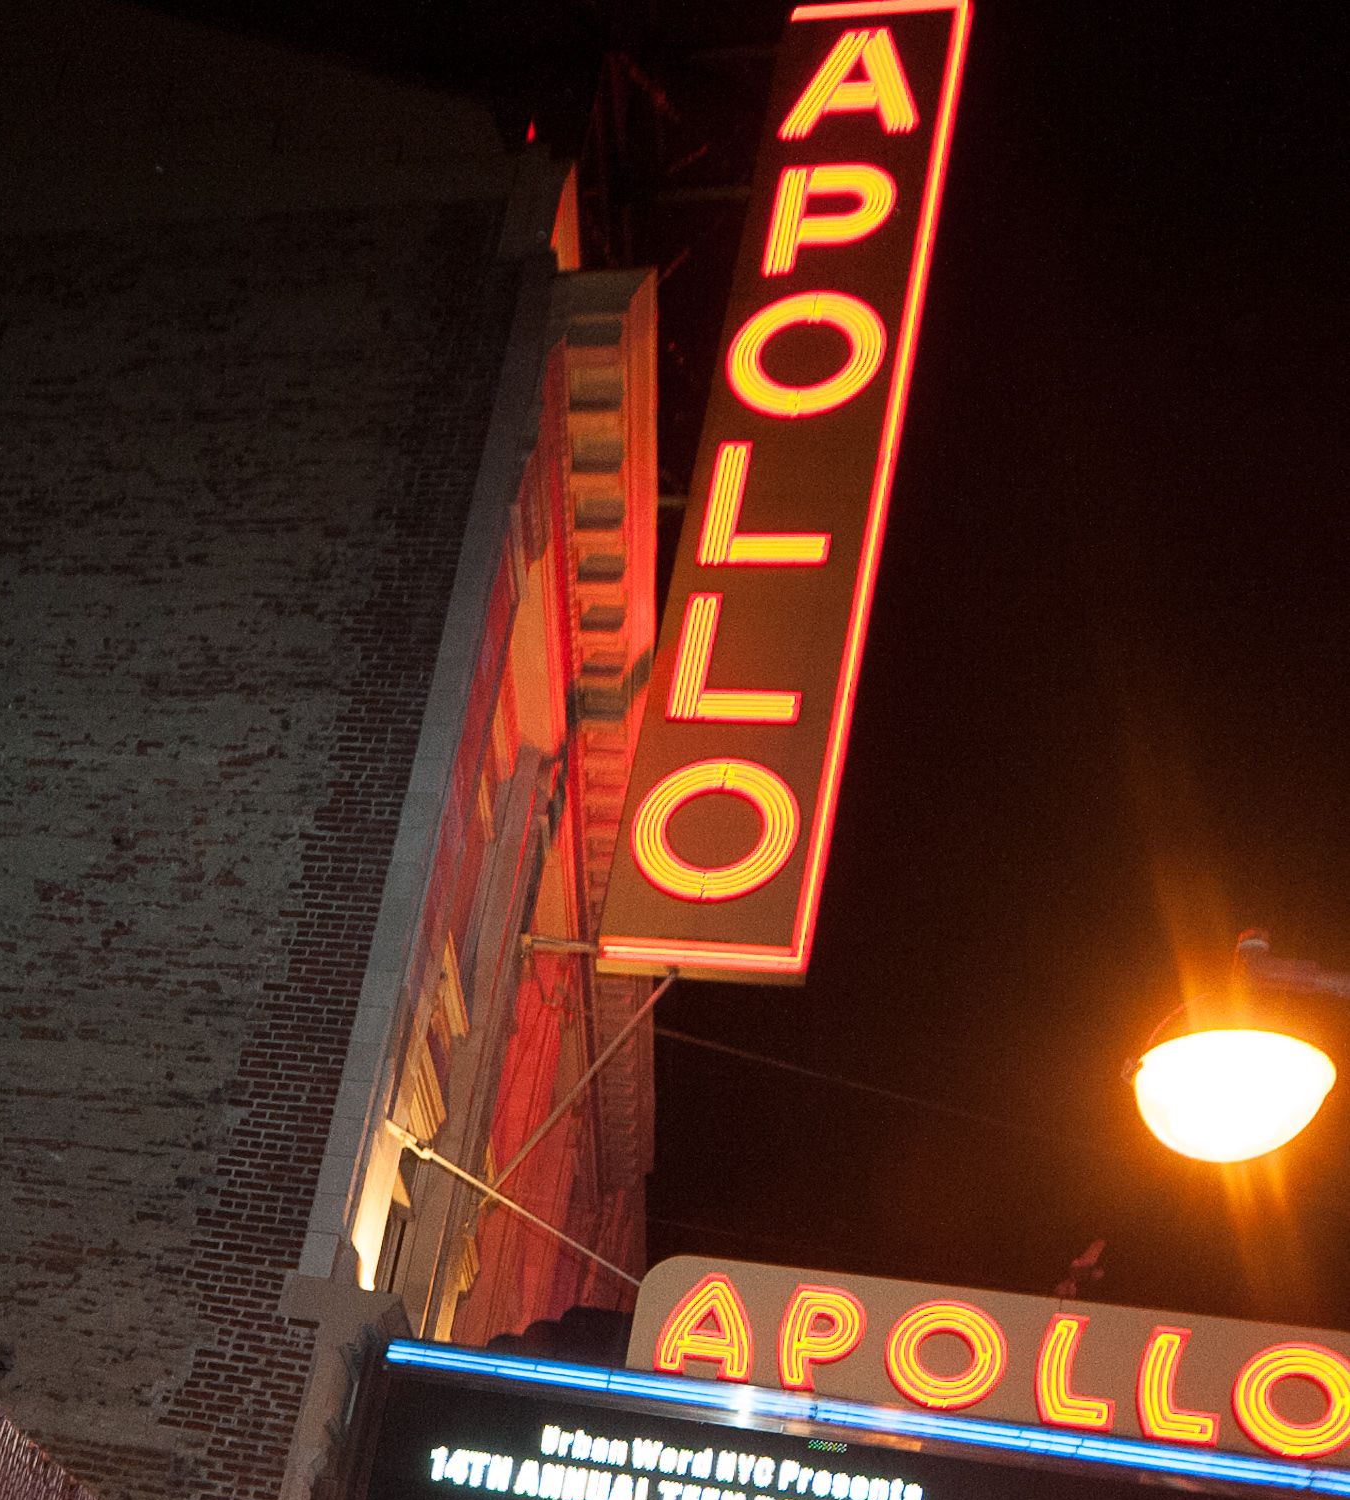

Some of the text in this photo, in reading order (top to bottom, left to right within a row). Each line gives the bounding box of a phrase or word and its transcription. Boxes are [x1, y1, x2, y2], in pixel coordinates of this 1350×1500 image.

[632, 27, 919, 902] APOLLO
[653, 1272, 1350, 1459] APOLLO
[429, 1445, 514, 1493] 14TH
[540, 1424, 629, 1467] Urban
[632, 1437, 714, 1480] Word
[714, 1449, 776, 1489] NYC
